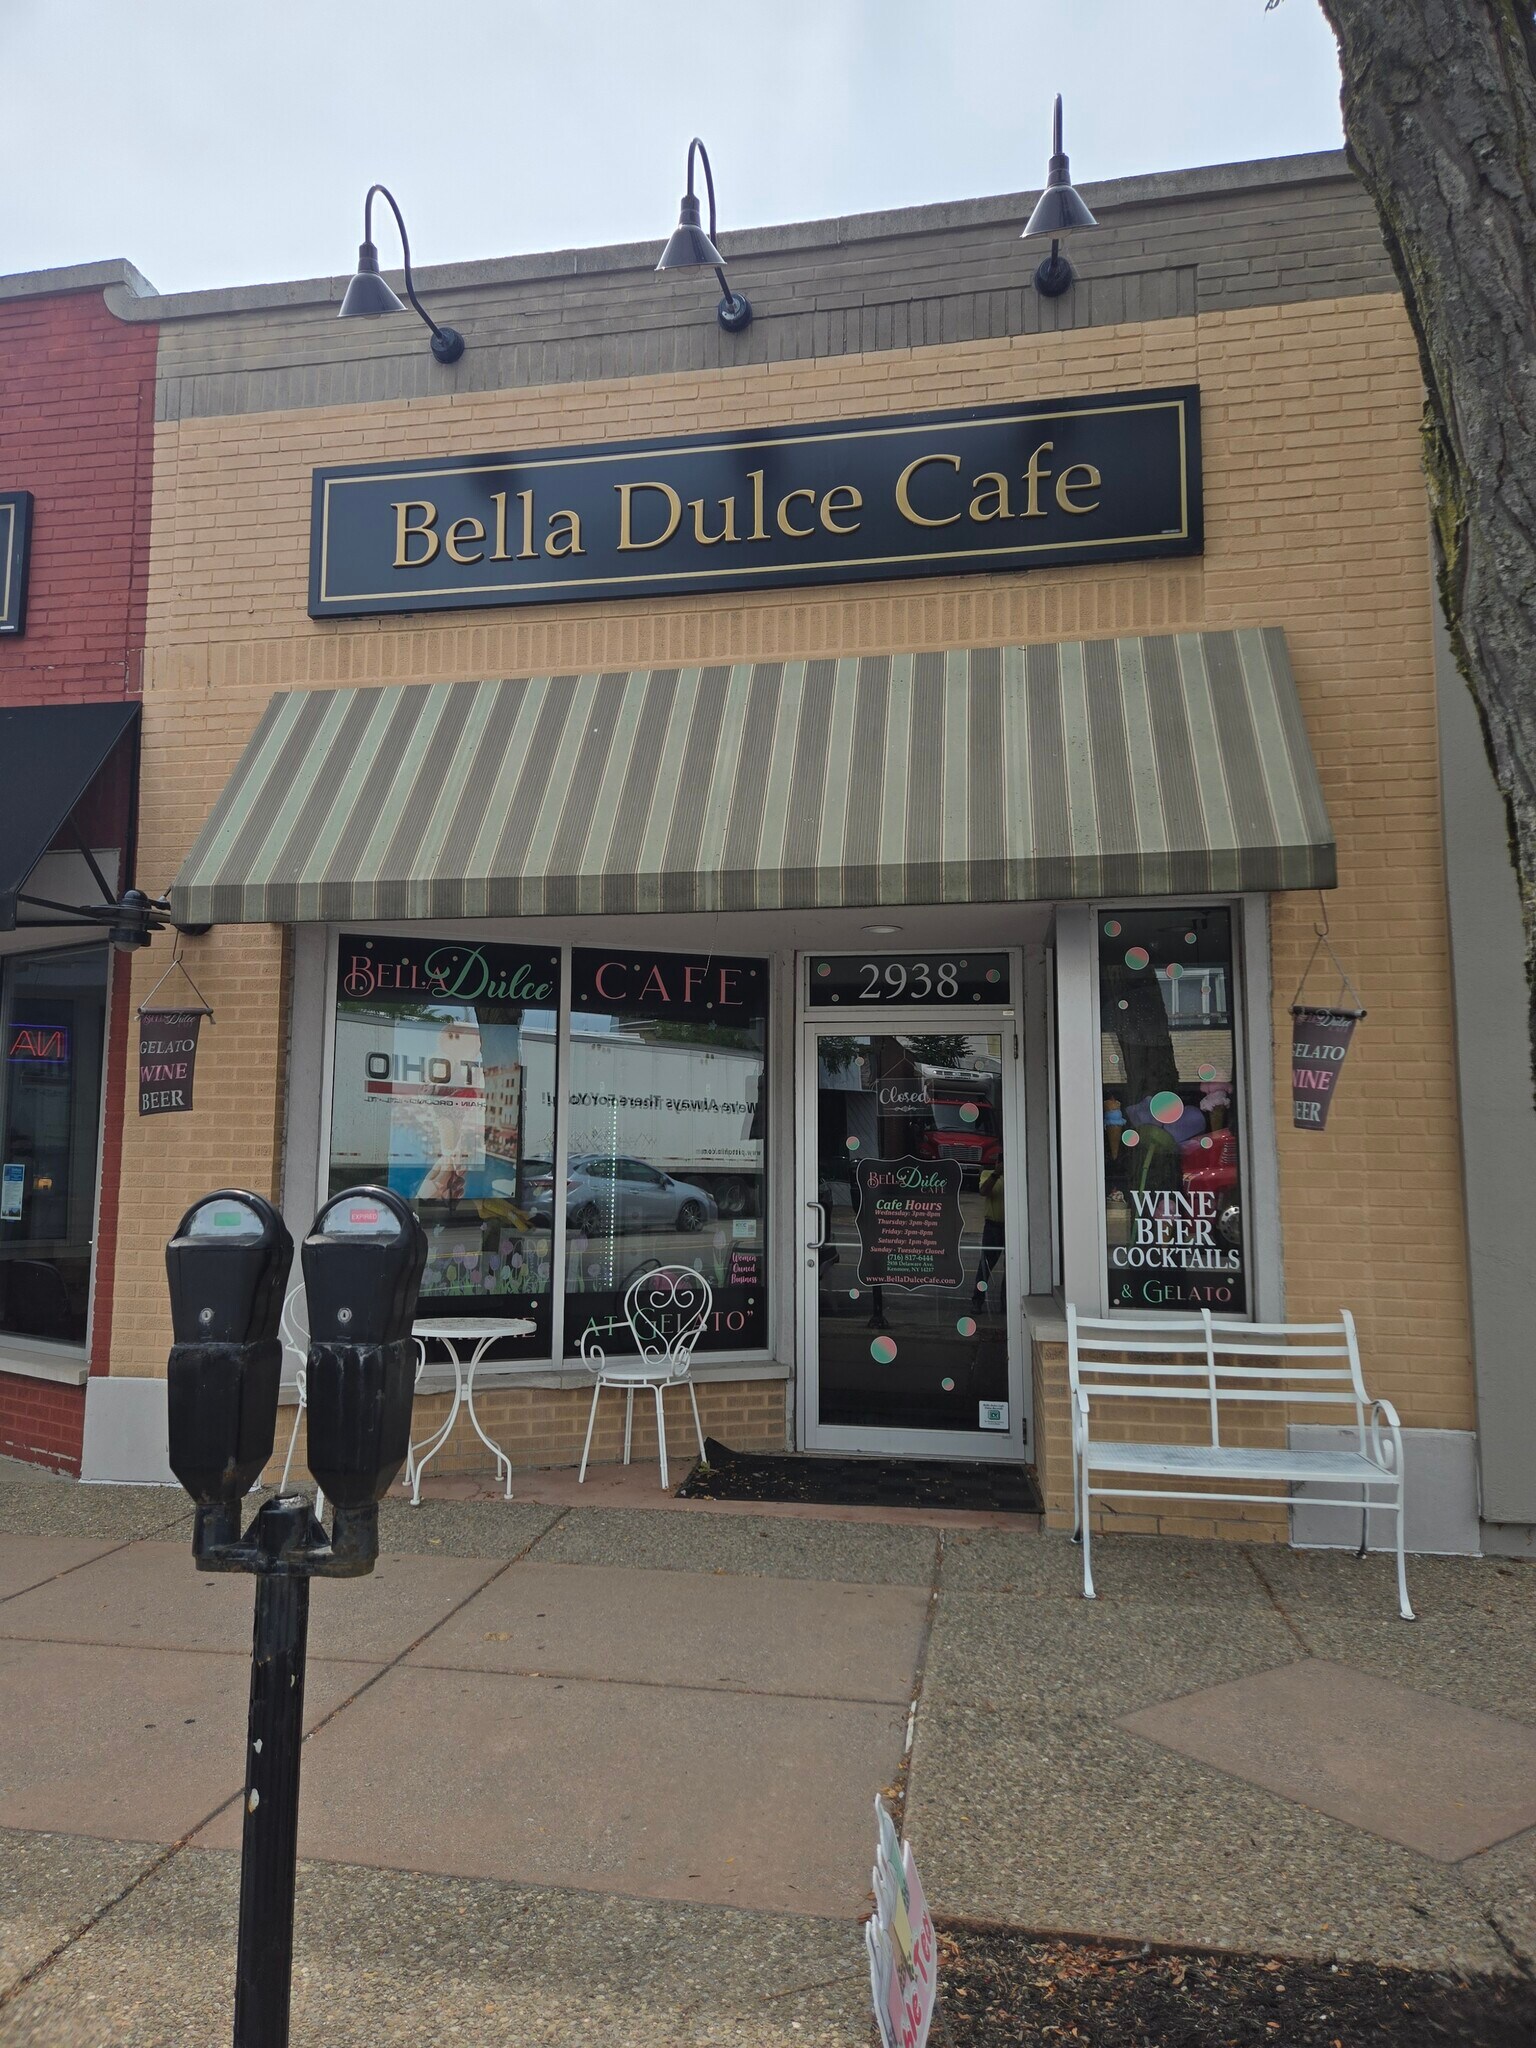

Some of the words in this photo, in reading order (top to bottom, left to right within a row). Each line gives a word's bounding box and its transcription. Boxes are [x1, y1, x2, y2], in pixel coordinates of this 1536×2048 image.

[390, 489, 586, 569] Bella
[614, 469, 863, 552] Dulce
[895, 441, 1101, 527] Cafe
[424, 944, 554, 1000] Dulce
[858, 963, 959, 999] 2938
[595, 962, 744, 1005] CAFE
[140, 1038, 195, 1055] GELATO
[1292, 1043, 1346, 1061] ELATO
[140, 1062, 188, 1083] WINE
[142, 1089, 185, 1111] BEER
[879, 1085, 931, 1105] Closed
[1294, 1100, 1322, 1122] EER
[896, 1165, 948, 1188] Dulce
[875, 1209, 910, 1217] Wednesday:
[877, 1199, 903, 1210] Cafe
[905, 1200, 943, 1211] Hours
[1130, 1190, 1217, 1218] WINE
[351, 1212, 378, 1222] EXPIRED
[879, 1218, 908, 1226] Thursday:
[879, 1237, 907, 1245] Saturday:
[882, 1228, 904, 1236] Friday:
[1135, 1218, 1217, 1247] BEER
[732, 1252, 757, 1263] Women
[871, 1245, 893, 1254] Sunday
[898, 1246, 924, 1254] Tuesday:
[905, 1254, 934, 1262] 817-6444
[1112, 1246, 1241, 1270] COCKTAILS
[866, 1275, 956, 1285] www.BellaDulceCafe.com
[1121, 1284, 1133, 1299] &
[1143, 1280, 1232, 1304] GELATO
[583, 1315, 618, 1338] AT
